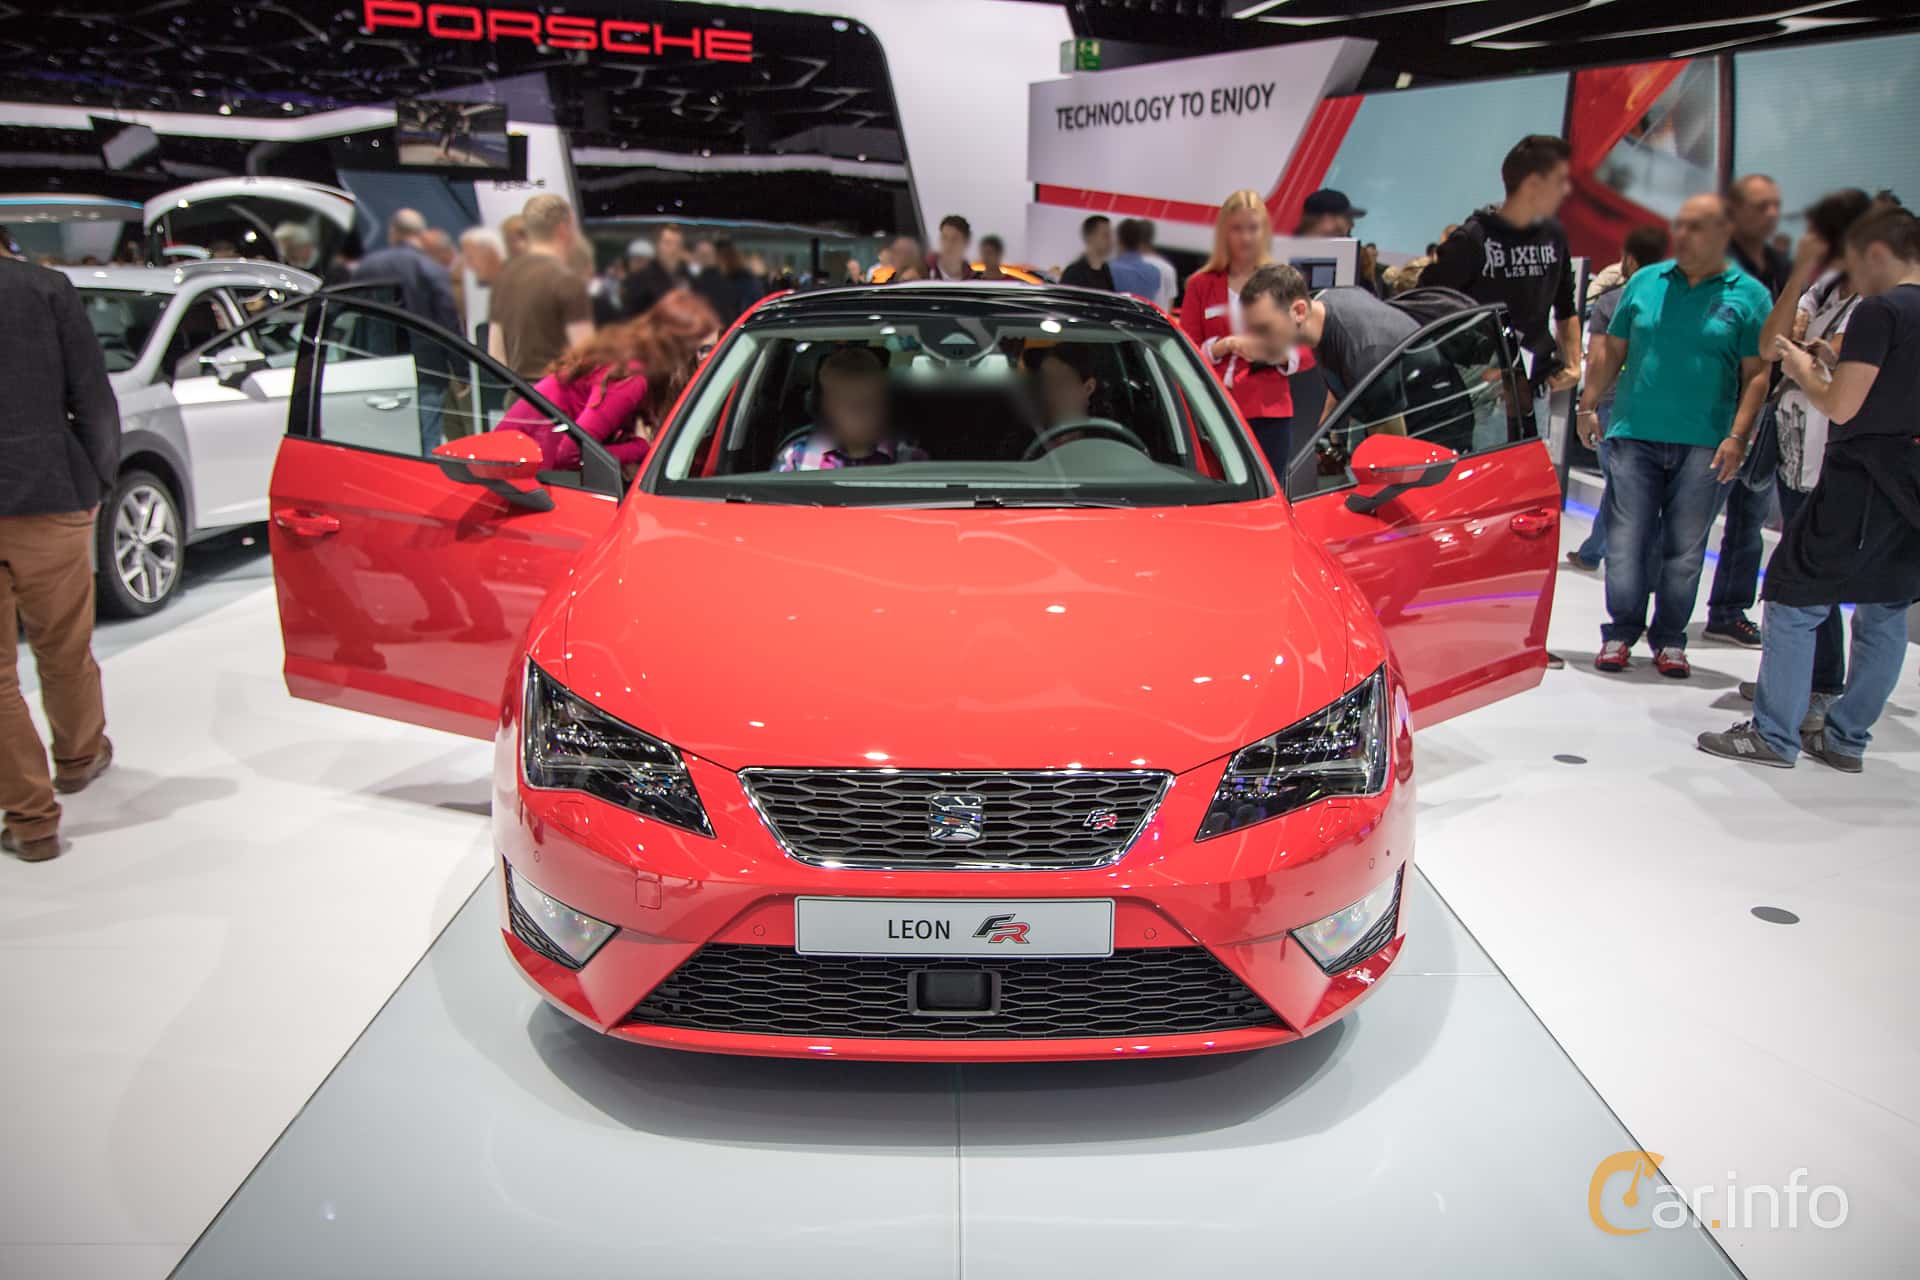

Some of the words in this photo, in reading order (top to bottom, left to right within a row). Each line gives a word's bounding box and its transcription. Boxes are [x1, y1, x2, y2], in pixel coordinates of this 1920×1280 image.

[363, 0, 753, 63] PORSCHE
[1056, 95, 1175, 131] TECHNOLOGY
[1180, 91, 1204, 117] TO
[1211, 82, 1276, 115] ENJOY
[888, 919, 950, 940] LEON
[972, 913, 1030, 944] FR
